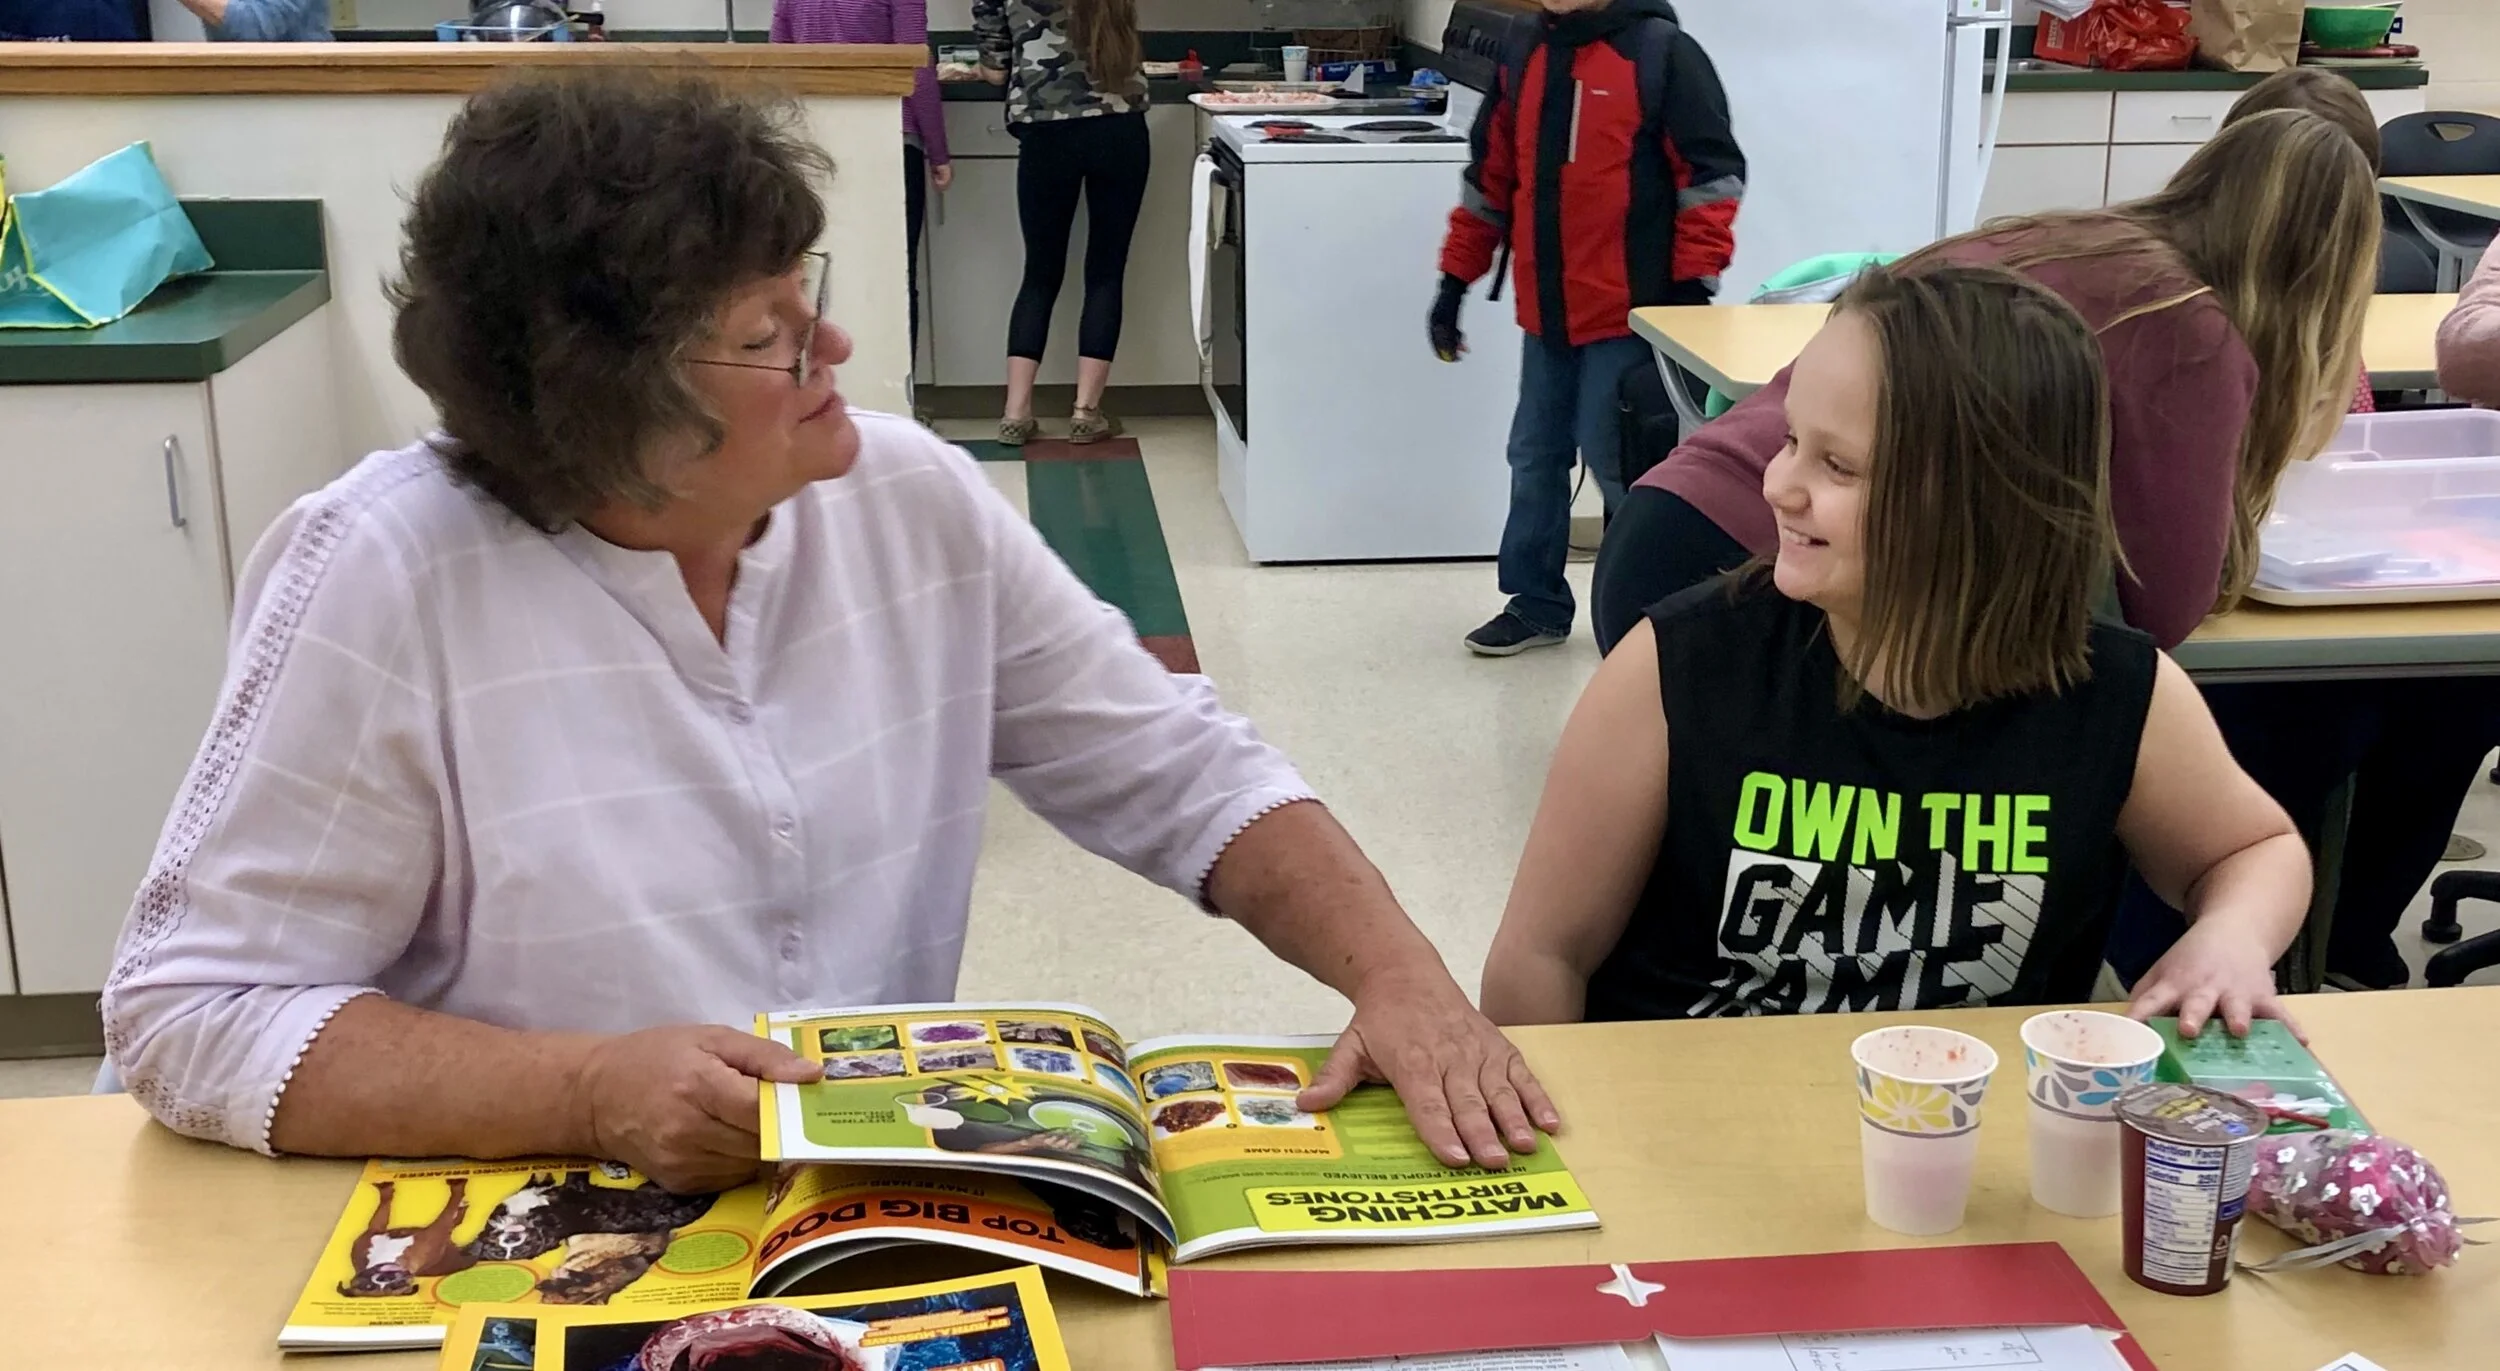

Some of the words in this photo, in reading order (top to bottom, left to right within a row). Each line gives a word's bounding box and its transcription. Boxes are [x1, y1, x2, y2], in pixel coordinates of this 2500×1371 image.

[1733, 771, 1902, 866] OWN
[1921, 792, 2050, 872] THE
[1719, 862, 2012, 958] GAME
[2146, 1138, 2192, 1157] Nutrition
[1323, 1172, 1388, 1181] BELIEVED
[1390, 1171, 1442, 1180] PEOPLE
[2146, 1167, 2180, 1182] Calories
[1265, 1181, 1529, 1206] BIRTHSTONES
[1308, 1191, 1568, 1222] MATCHING
[879, 1199, 971, 1225] BIG
[760, 1201, 867, 1262] DOG
[981, 1214, 1065, 1245] TOP
